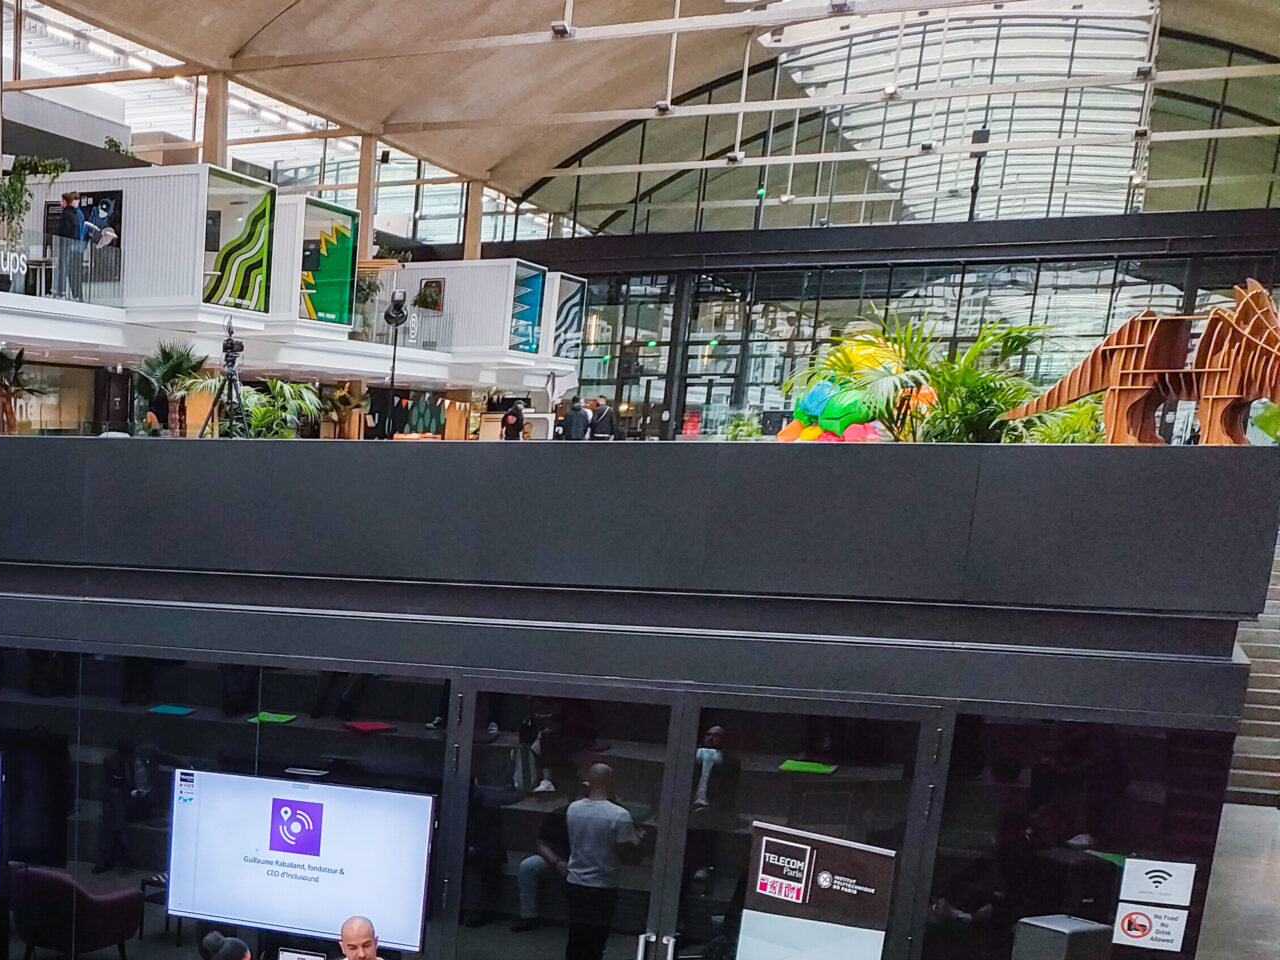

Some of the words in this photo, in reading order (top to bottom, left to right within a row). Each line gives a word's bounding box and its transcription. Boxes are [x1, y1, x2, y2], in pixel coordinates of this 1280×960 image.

[243, 855, 274, 866] Guillaume
[307, 863, 338, 875] fondateur
[764, 852, 805, 870] TELECOM
[266, 869, 280, 877] CEO
[783, 866, 803, 879] Paris
[833, 875, 857, 884] INSTITUT
[833, 879, 876, 894] POLYTECHNIQUE
[841, 886, 858, 895] PARIS
[1163, 914, 1179, 922] Food
[1149, 936, 1174, 944] Allowed
